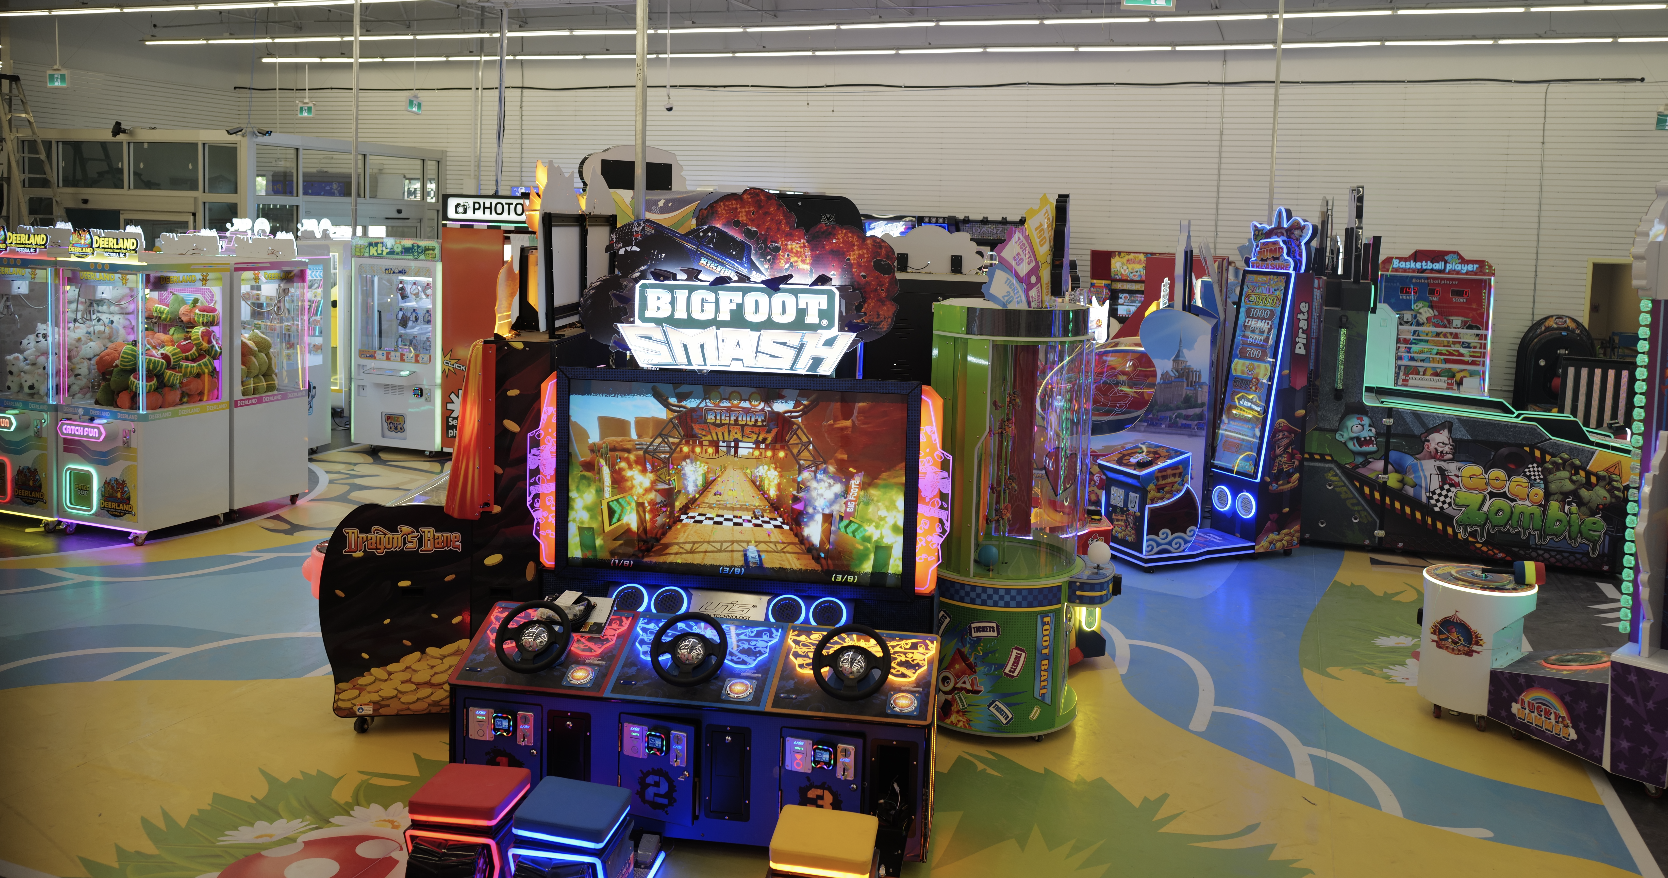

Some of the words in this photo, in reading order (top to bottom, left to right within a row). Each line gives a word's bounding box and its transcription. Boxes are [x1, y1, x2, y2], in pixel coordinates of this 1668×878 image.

[472, 201, 525, 216] PHOTO
[7, 232, 47, 245] DEERLAND
[1034, 221, 1047, 248] 100
[93, 235, 137, 250] DEERLAND
[1014, 236, 1034, 266] TICKETS
[1256, 245, 1284, 260] JUMP
[1012, 252, 1025, 267] 50
[1250, 260, 1290, 271] TREASURE
[1392, 258, 1445, 270] Basketball
[1446, 262, 1479, 273] player
[0, 266, 26, 276] EERLAND
[80, 271, 116, 281] DEERLAND
[160, 274, 197, 285] DEERLAND
[1002, 291, 1015, 305] 20
[1004, 277, 1023, 305] TICKETS
[1403, 287, 1418, 295] 142
[1434, 288, 1441, 296] 0
[1463, 289, 1469, 297] 0
[644, 288, 829, 324] BIGFOOT
[1249, 308, 1271, 319] 1000
[1244, 318, 1272, 329] DEMO
[1294, 301, 1309, 355] Pirate
[616, 323, 858, 375] SMASH
[1245, 348, 1262, 359] 700
[443, 360, 467, 371] CLICK
[0, 418, 10, 428] UN
[448, 417, 458, 426] Se
[706, 410, 765, 426] BIGFOOT
[62, 424, 84, 436] CATCH
[84, 426, 99, 438] FUN
[448, 429, 457, 438] ph
[692, 423, 779, 444] SMASH
[14, 488, 45, 499] DEERLAND
[100, 500, 134, 512] DEERLAND
[1452, 490, 1607, 557] Zombie
[343, 525, 420, 556] Dragon's
[419, 527, 462, 553] Bane
[610, 559, 634, 568] (1/8)
[719, 566, 745, 576] (3/8)
[831, 573, 858, 583] (3/8)
[972, 625, 996, 634] TICKETS
[1041, 616, 1051, 656] FOOT
[1008, 651, 1022, 675] TICKETS
[939, 670, 984, 695] OAL
[1039, 659, 1049, 697] BALL
[992, 703, 1010, 721] TICKETS
[1520, 696, 1561, 724] LUCKY
[1517, 707, 1571, 741] HAMMER
[644, 774, 669, 805] 2
[806, 787, 834, 811] 3
